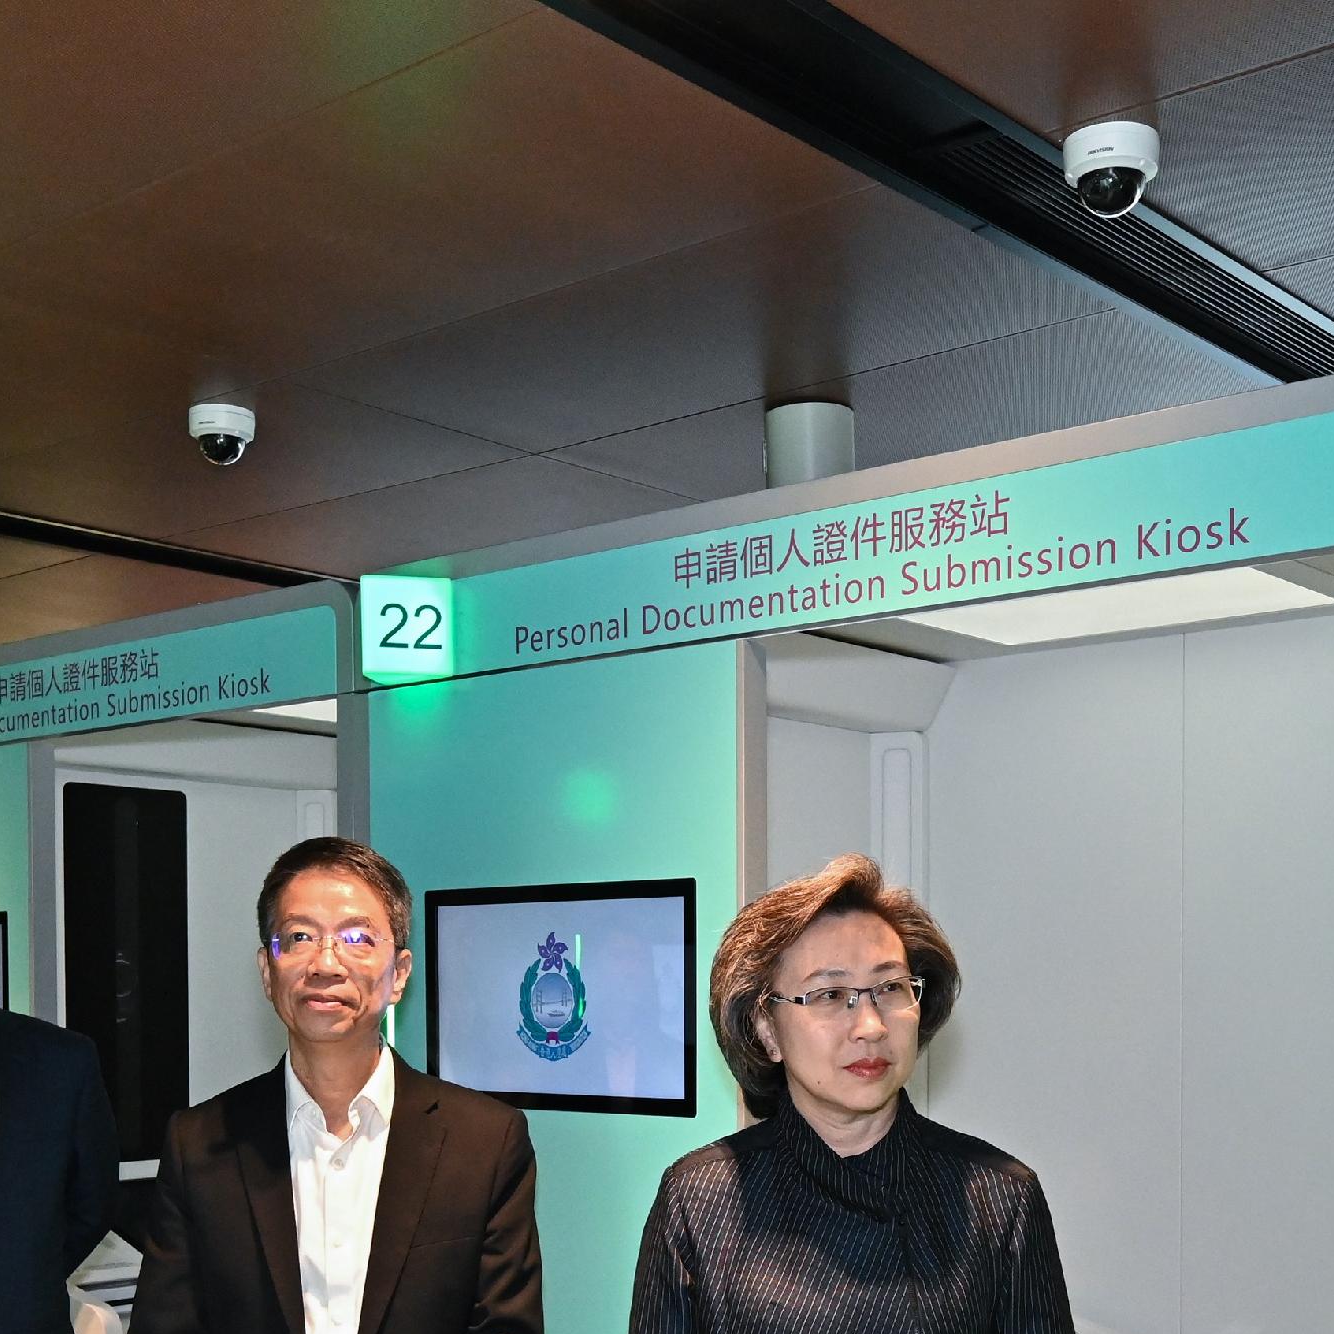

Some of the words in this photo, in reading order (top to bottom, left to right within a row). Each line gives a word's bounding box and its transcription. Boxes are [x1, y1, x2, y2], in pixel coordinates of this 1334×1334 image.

[674, 490, 1010, 590] 申請個人證件服務站
[515, 608, 628, 654] Personal
[642, 573, 885, 635] Documentation
[902, 537, 1116, 595] Submission
[1136, 508, 1250, 560] Kiosk
[379, 603, 443, 651] 22
[107, 682, 210, 717] Submission
[219, 668, 272, 700] Kiosk
